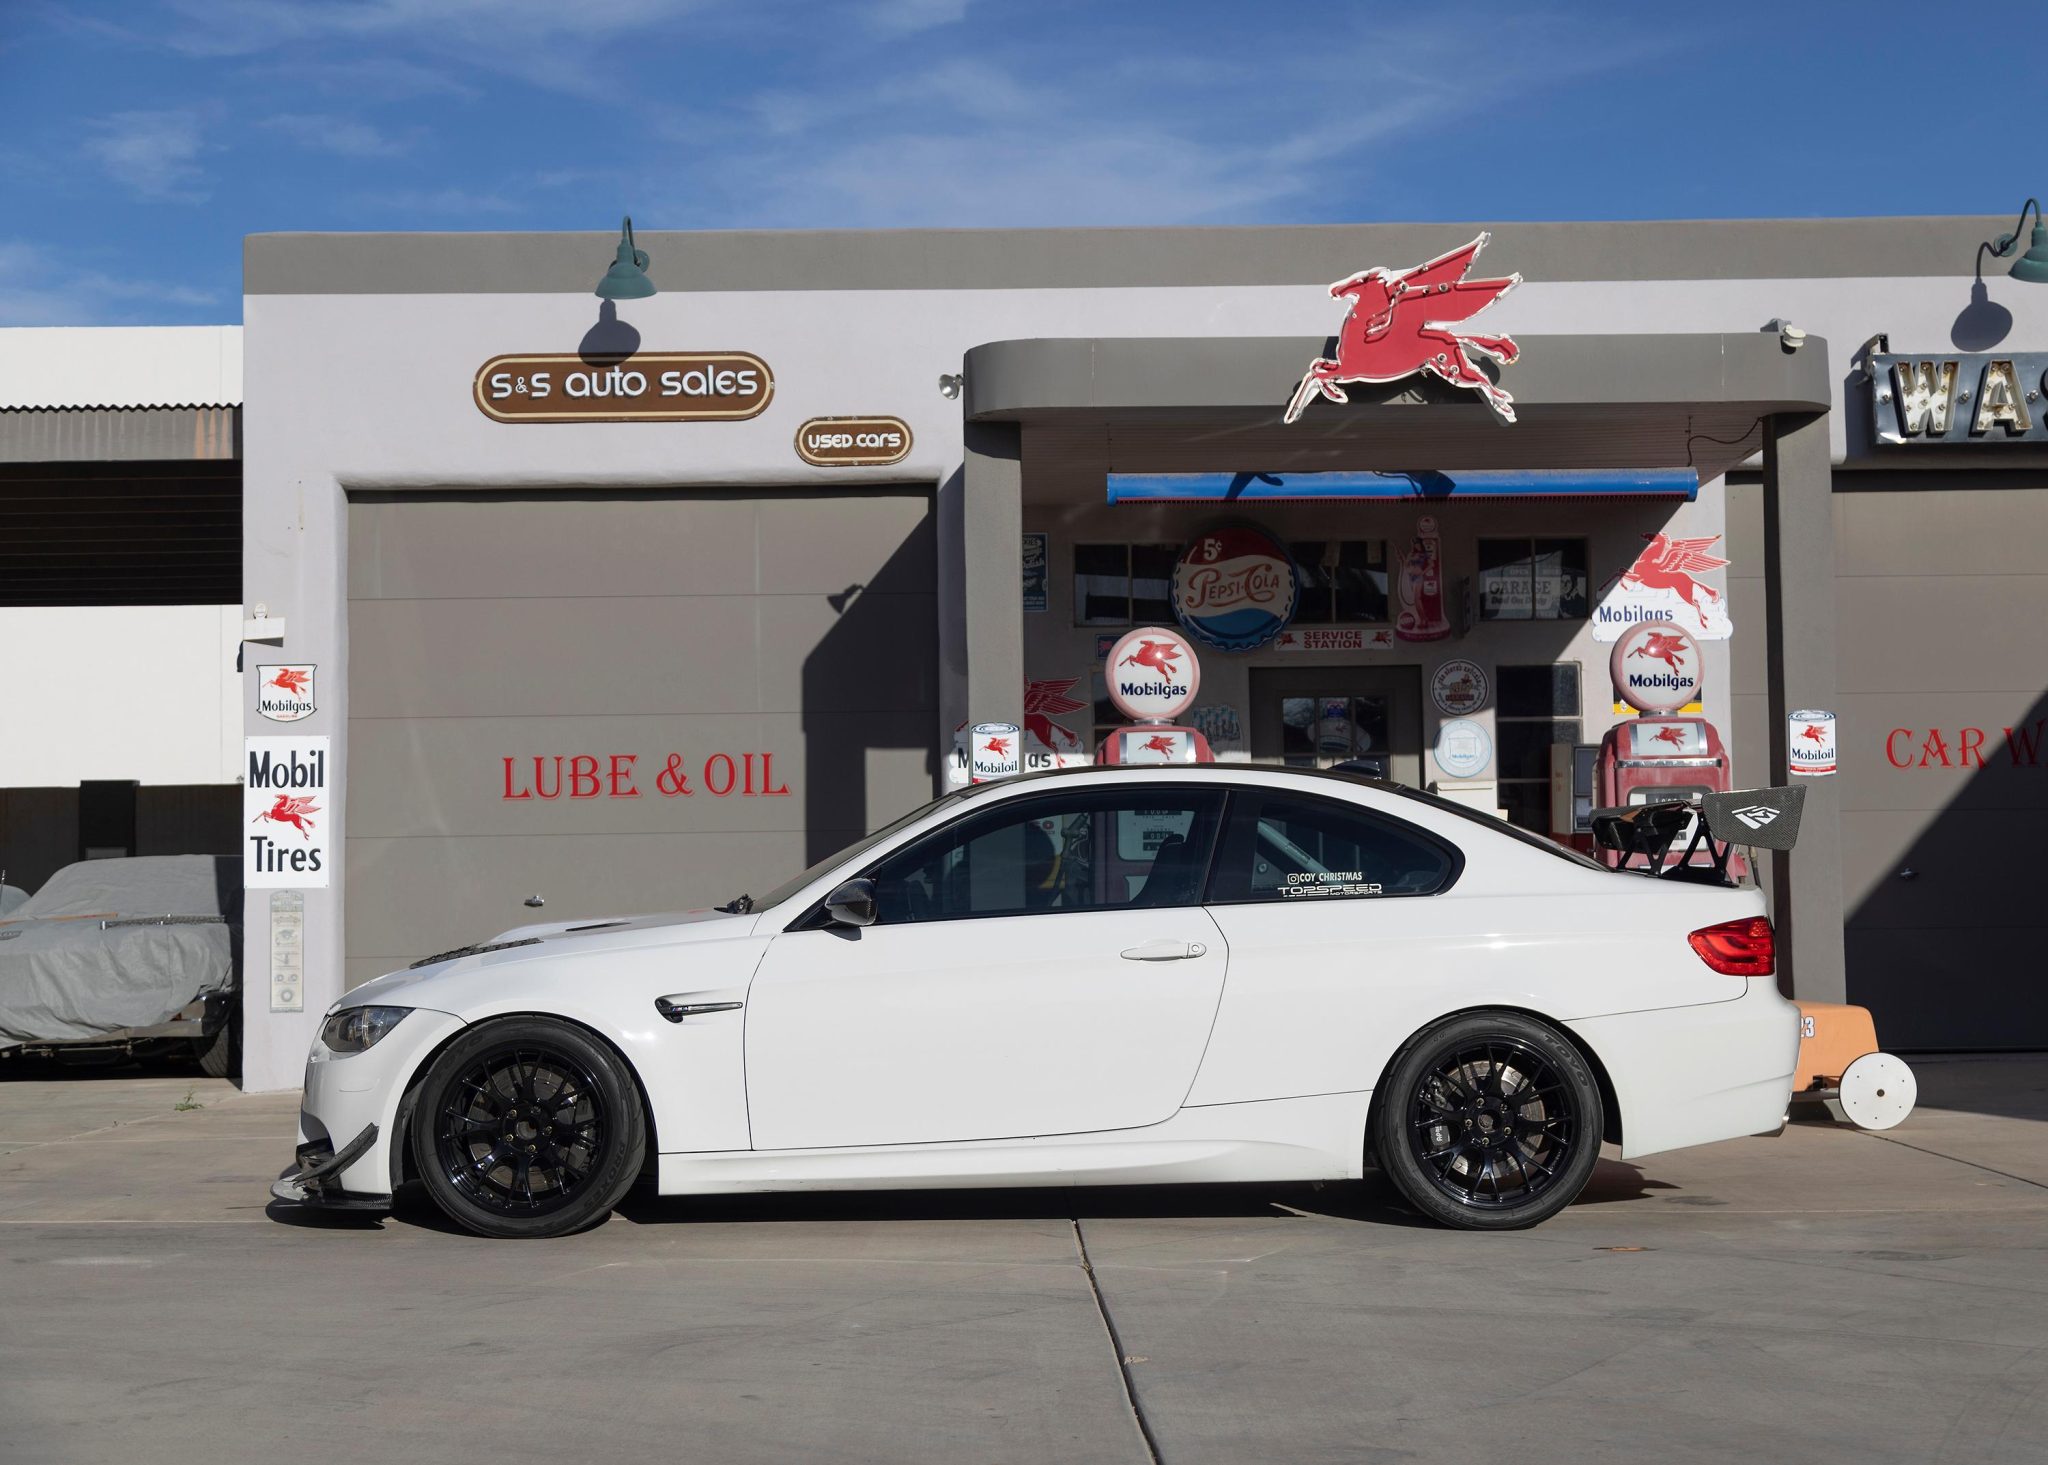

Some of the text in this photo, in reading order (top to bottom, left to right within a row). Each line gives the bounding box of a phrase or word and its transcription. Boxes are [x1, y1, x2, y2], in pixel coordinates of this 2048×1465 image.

[562, 365, 647, 398] auto
[661, 364, 759, 397] sales
[1890, 359, 2048, 436] WA
[1599, 605, 1674, 622] Mobilgas
[1304, 631, 1362, 640] SERVICE
[1304, 640, 1362, 648] STATION
[1629, 673, 1694, 690] Mobilgas
[1121, 682, 1187, 699] Mobilgas
[262, 699, 311, 714] Mobilgas
[1886, 718, 2048, 769] CAR W
[1792, 748, 1834, 760] Mobiloil
[249, 750, 324, 789] Mobil
[974, 760, 1018, 773] Mobiloil
[502, 753, 792, 800] LUBE & OIL
[250, 836, 322, 872] Tires
[1545, 1033, 1589, 1087] TOYO
